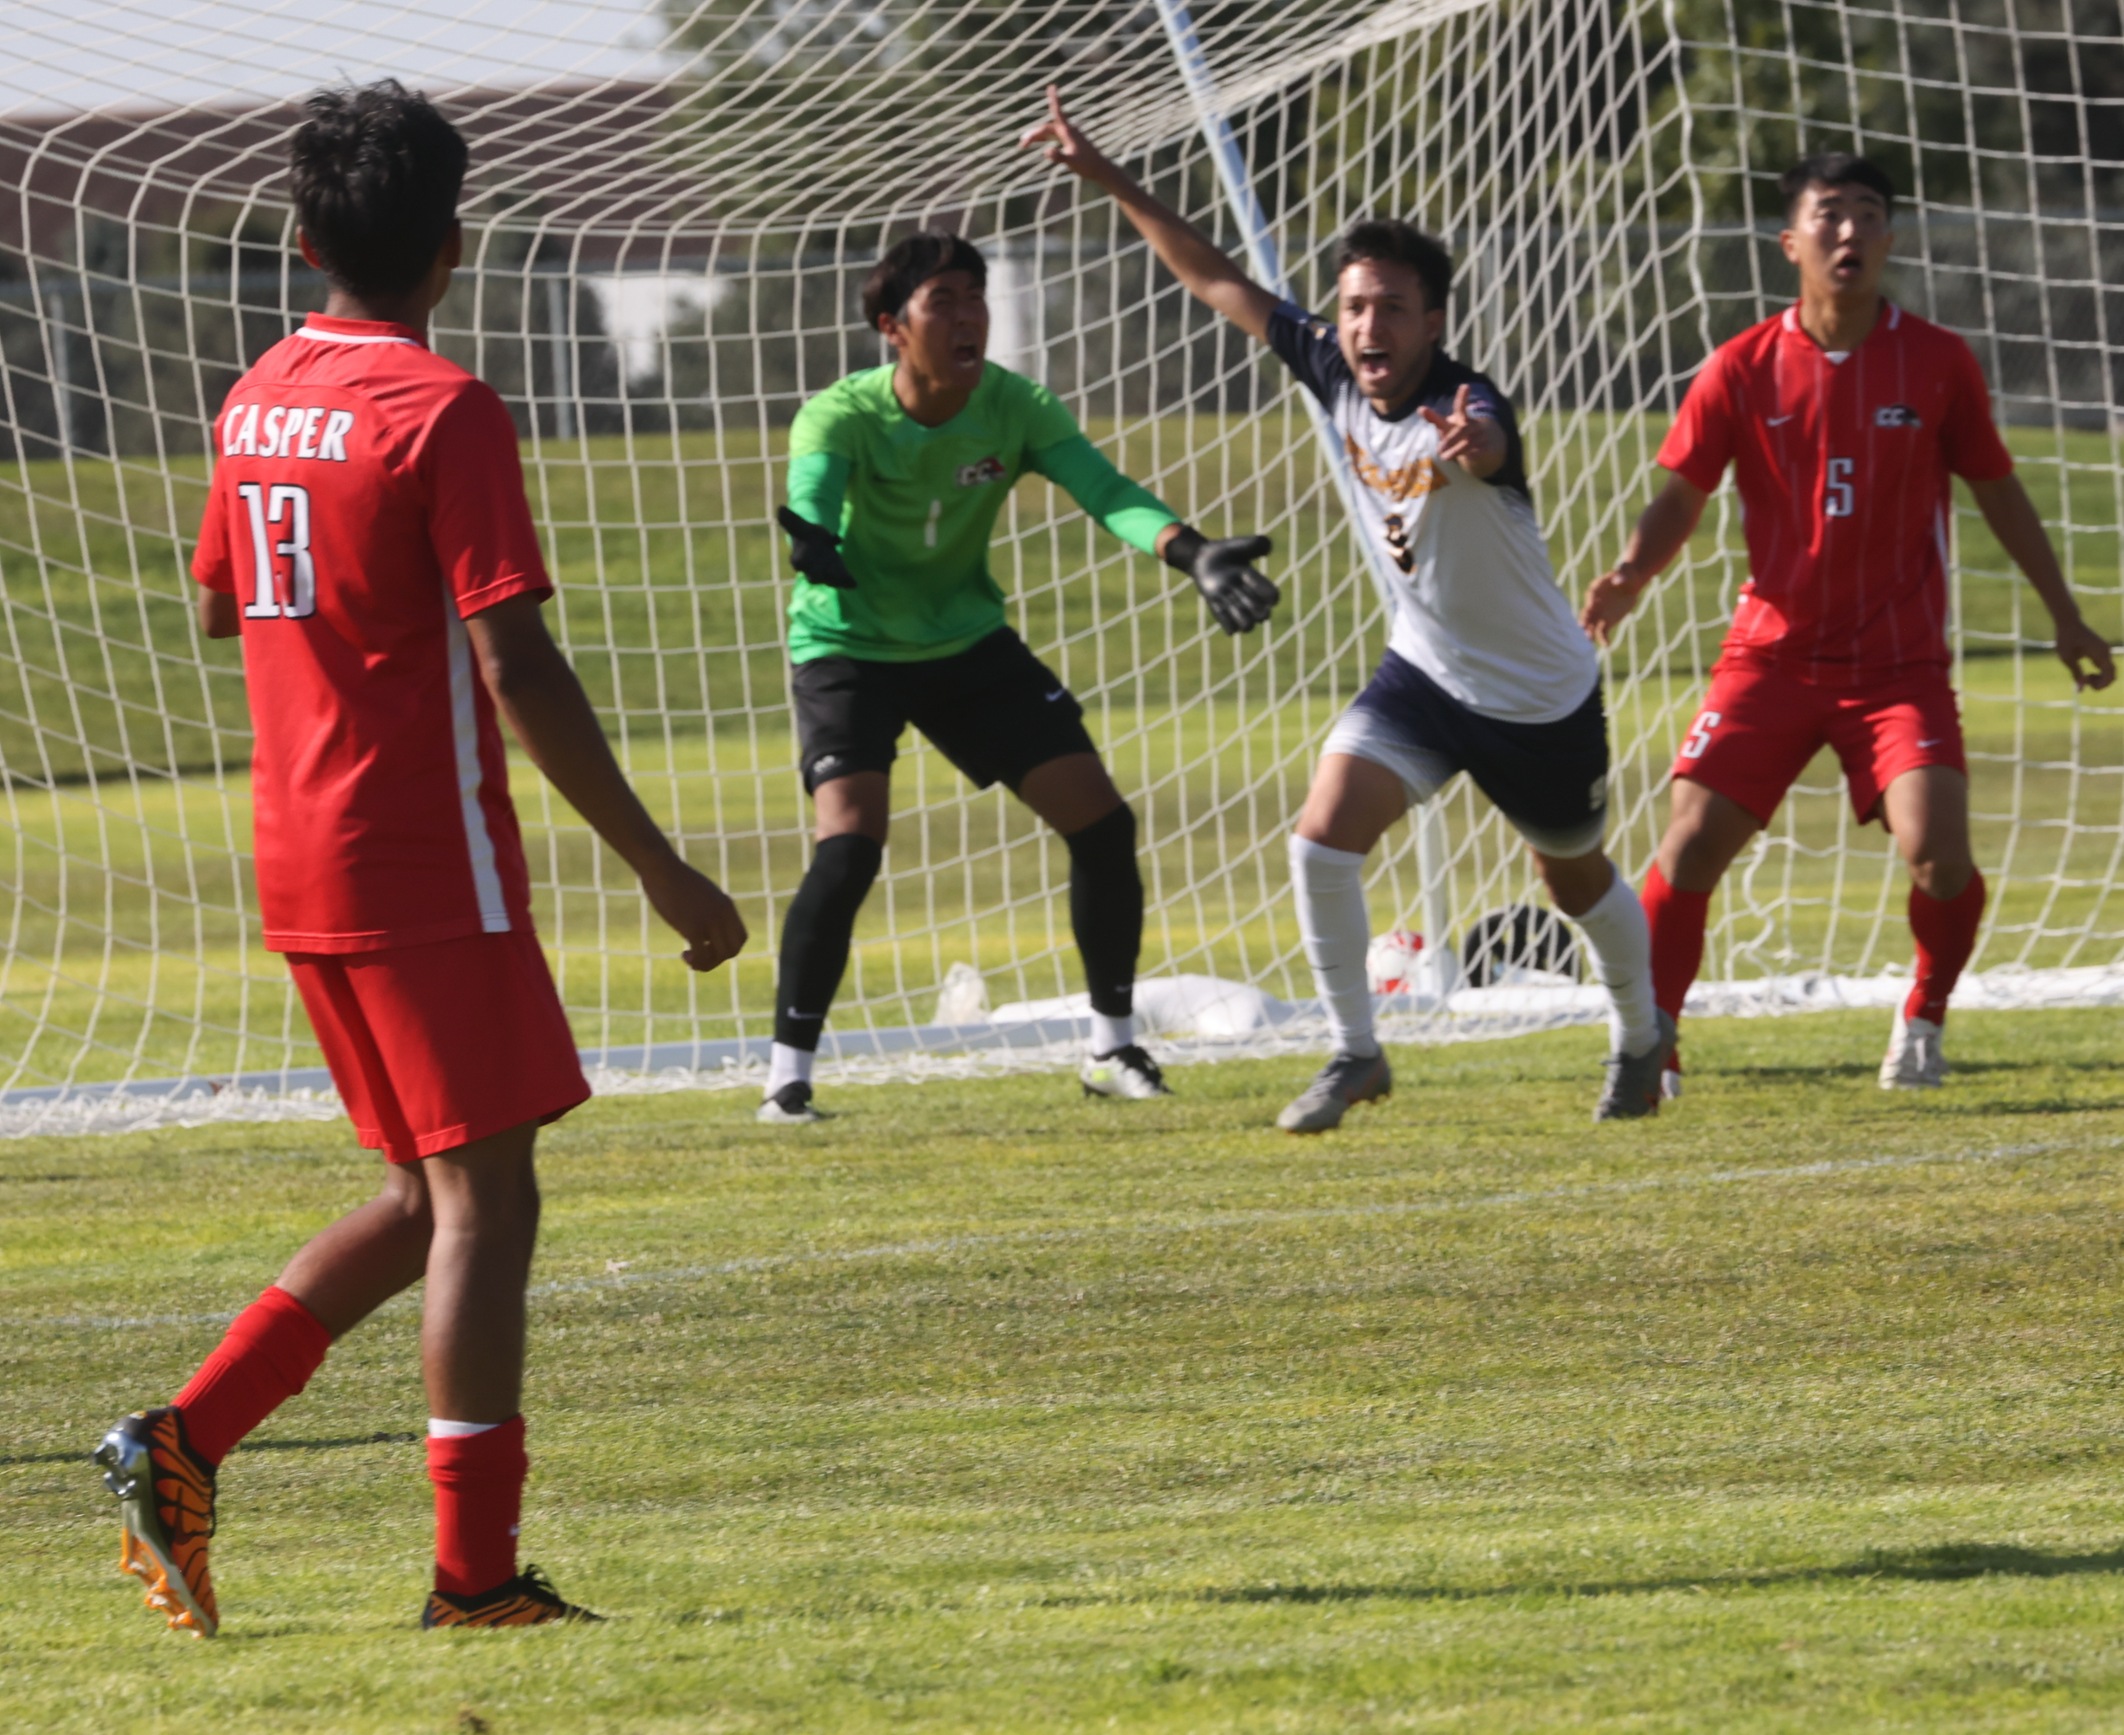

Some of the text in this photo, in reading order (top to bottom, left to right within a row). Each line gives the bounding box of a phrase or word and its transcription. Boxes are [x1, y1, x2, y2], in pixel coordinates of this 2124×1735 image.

[222, 403, 354, 462] CASPER
[1826, 457, 1854, 518] 5
[238, 481, 317, 619] 13
[924, 498, 942, 548] 1
[1680, 710, 1722, 759] 5
